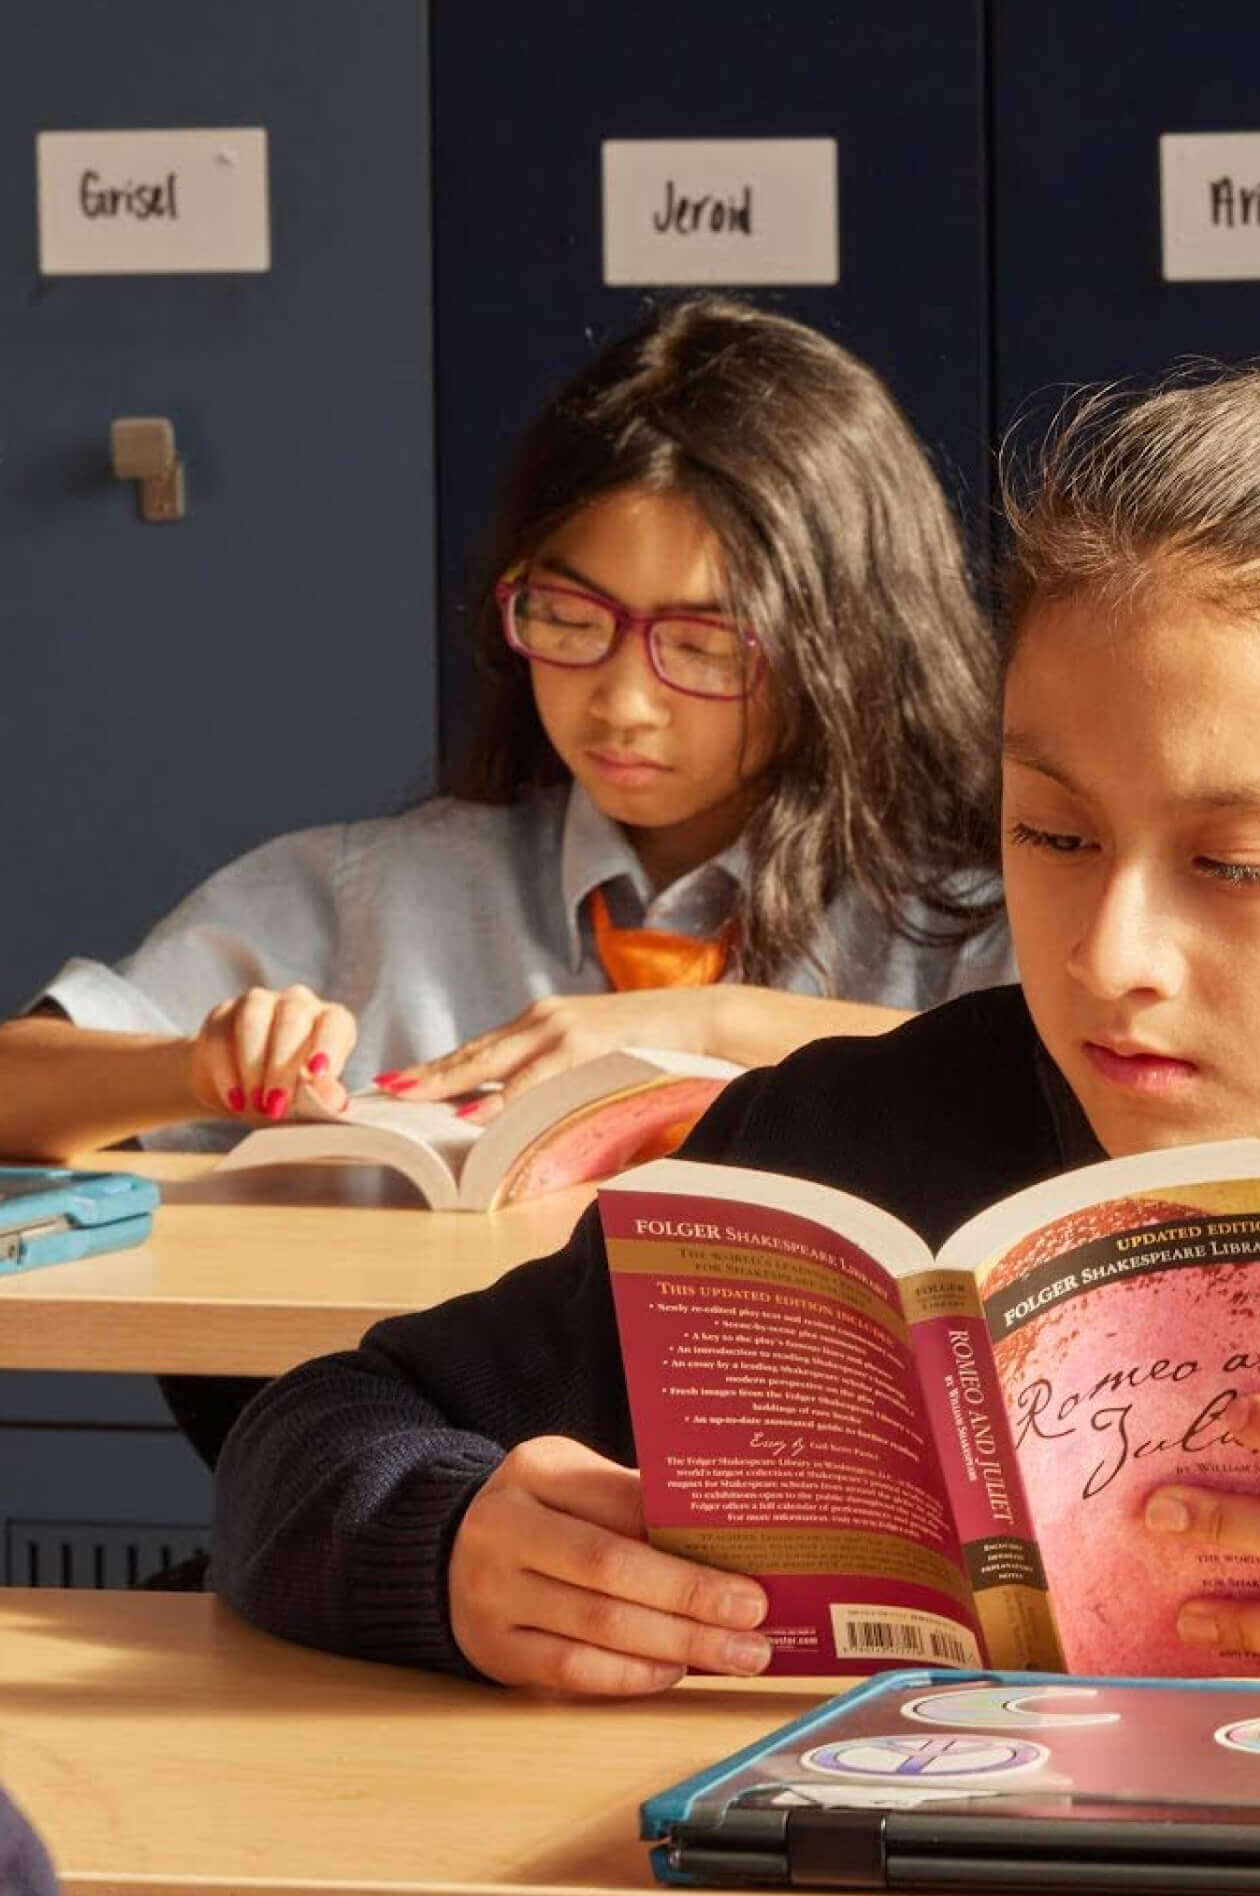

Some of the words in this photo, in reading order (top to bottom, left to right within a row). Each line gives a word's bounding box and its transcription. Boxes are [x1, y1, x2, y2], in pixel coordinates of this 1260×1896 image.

[78, 168, 179, 221] Grisel
[635, 1219, 721, 1239] FOLGER
[725, 1226, 838, 1267] SHAKESPEARE
[1116, 1226, 1202, 1251] UPDATED
[656, 1280, 696, 1297] THIS
[699, 1286, 771, 1304] UPDATED
[774, 1294, 834, 1317] EDITION
[1003, 1274, 1080, 1328] FOLGER
[1081, 1245, 1206, 1284] SHAKESPEARE
[948, 1330, 985, 1404] ROMEO
[1015, 1358, 1199, 1449] Romeo
[968, 1409, 996, 1455] AND
[974, 1457, 1014, 1525] JULIET
[1197, 1462, 1250, 1475] WILLIAM
